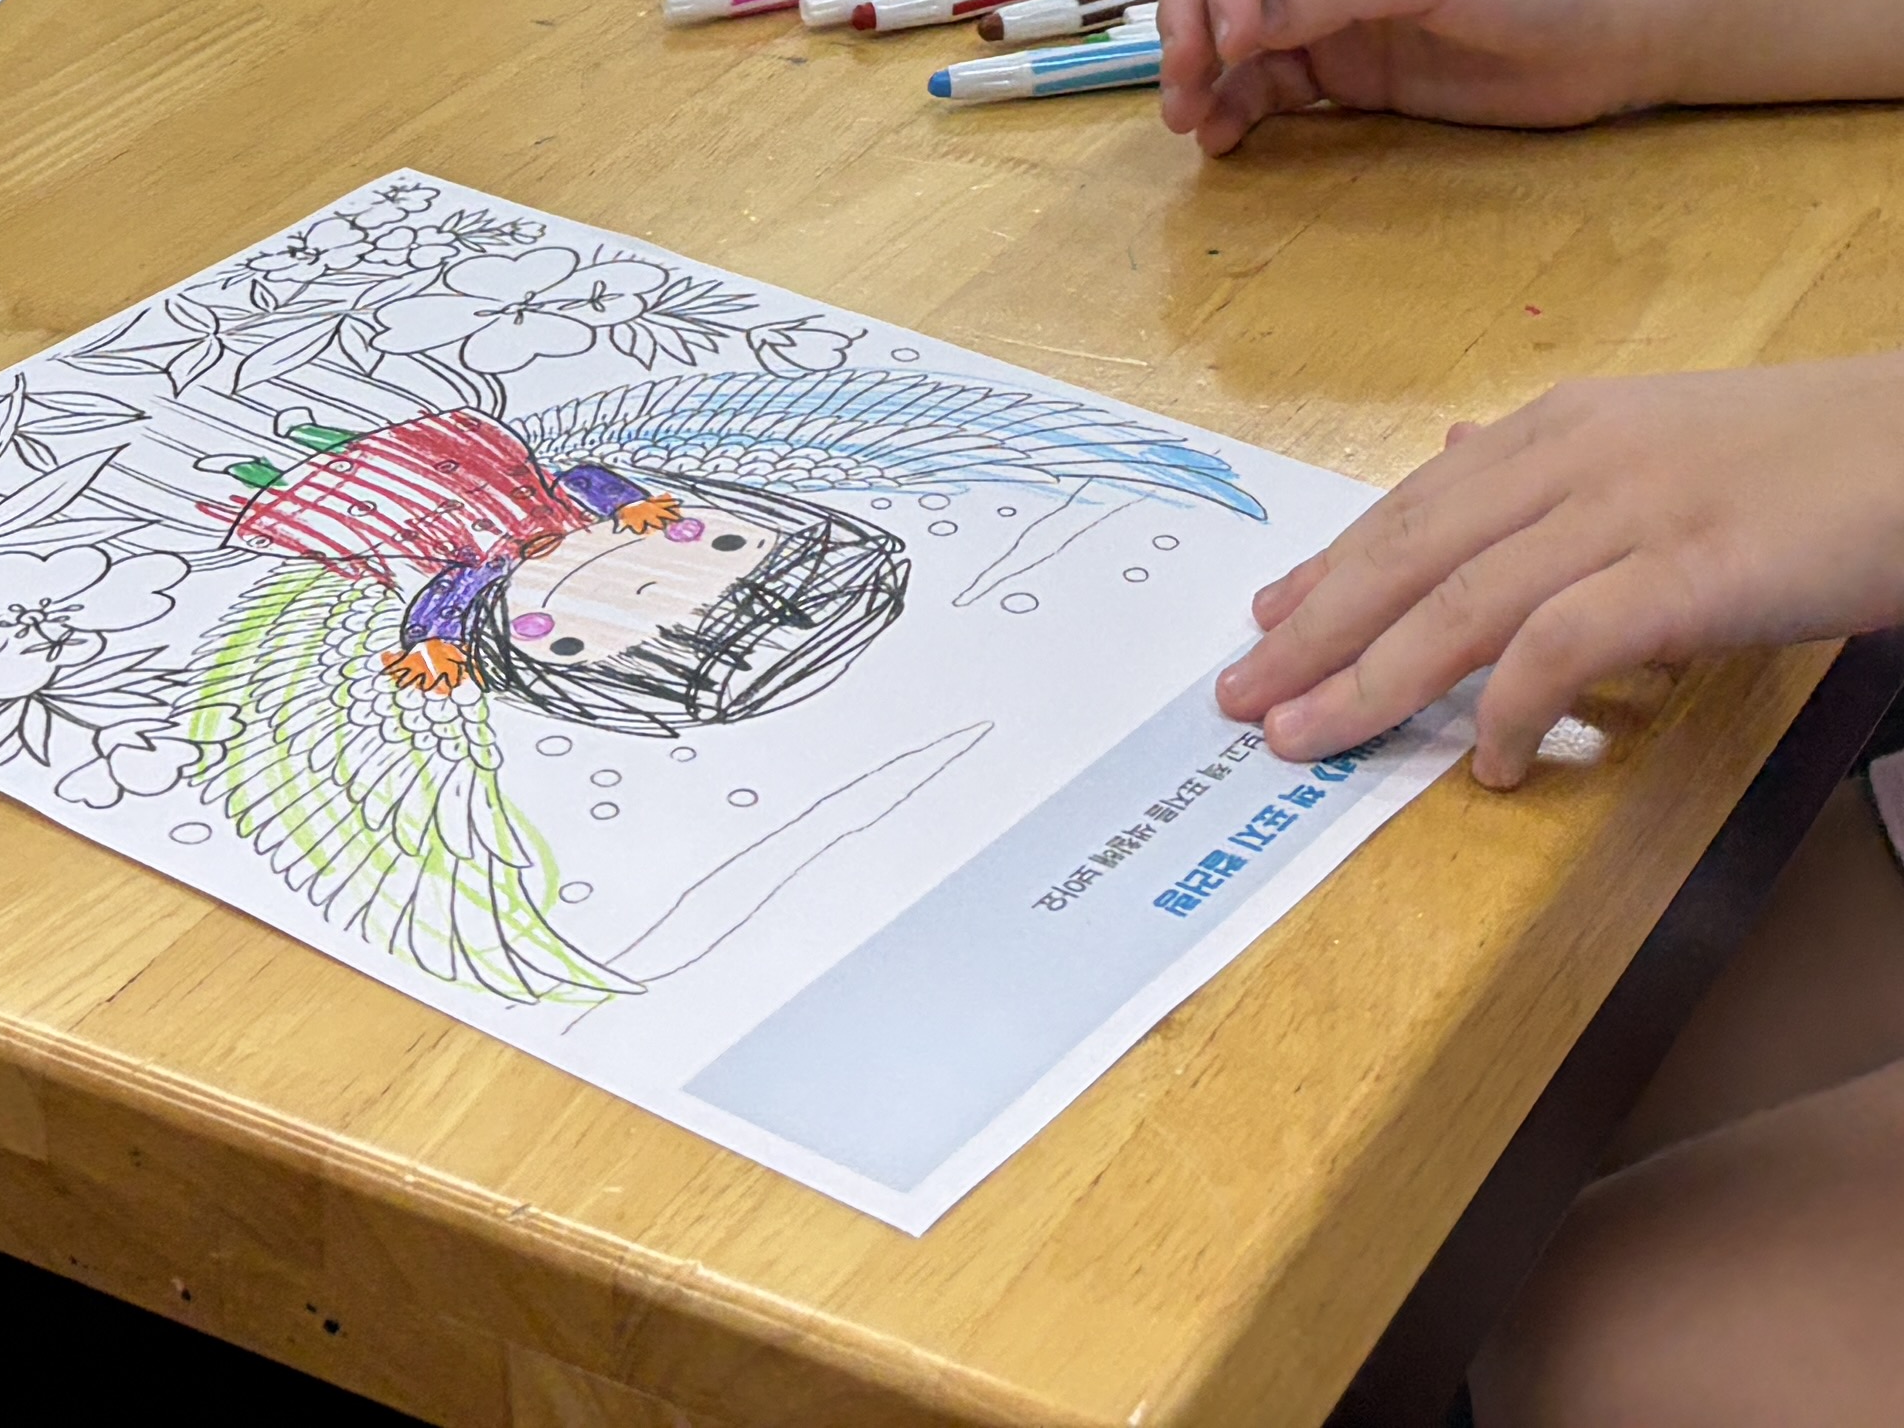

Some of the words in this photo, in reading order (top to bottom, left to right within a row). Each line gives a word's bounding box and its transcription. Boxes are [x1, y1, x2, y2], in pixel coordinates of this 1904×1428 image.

[1218, 731, 1266, 762] 보고
[1196, 762, 1233, 781] 책
[1144, 777, 1211, 824] 표지를
[1278, 784, 1326, 808] 책
[1087, 823, 1158, 869] 색칠해
[1227, 804, 1299, 852] 표지
[1152, 848, 1249, 918] 컬러링
